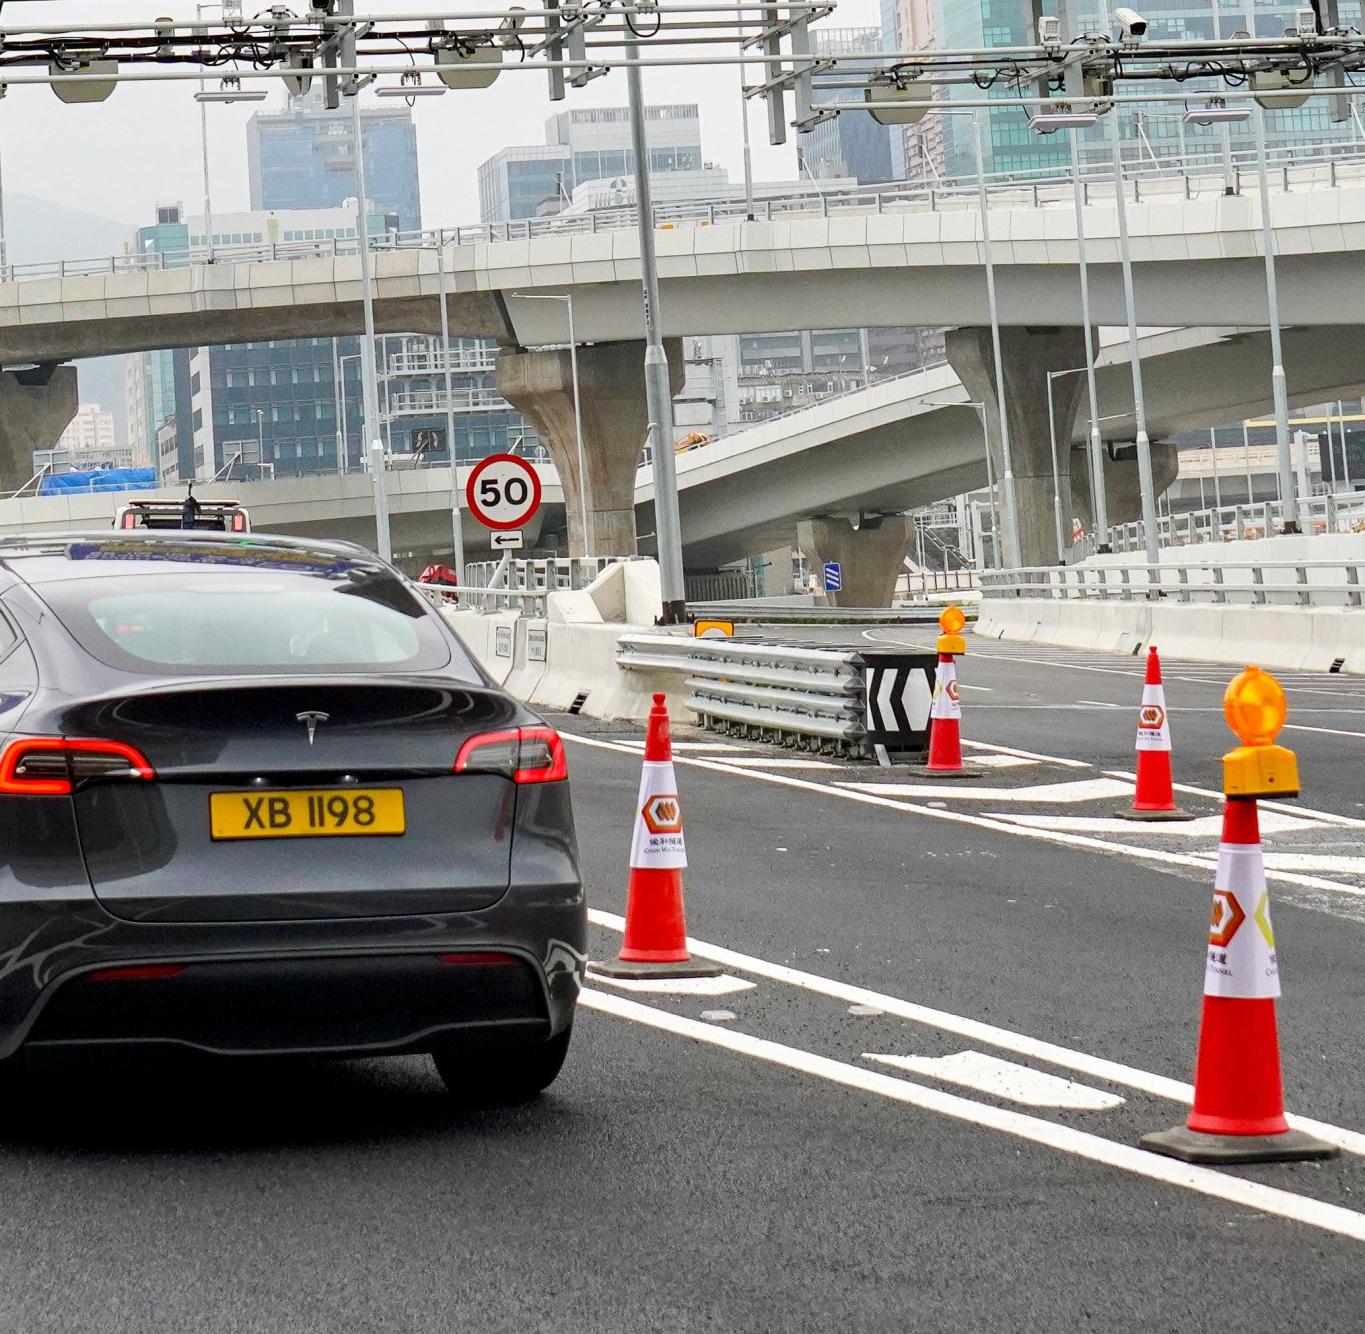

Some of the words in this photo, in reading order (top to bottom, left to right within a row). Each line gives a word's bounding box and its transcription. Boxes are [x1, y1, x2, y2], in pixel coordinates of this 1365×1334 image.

[480, 477, 528, 508] 50
[242, 796, 292, 830] XB
[307, 794, 376, 828] 1198
